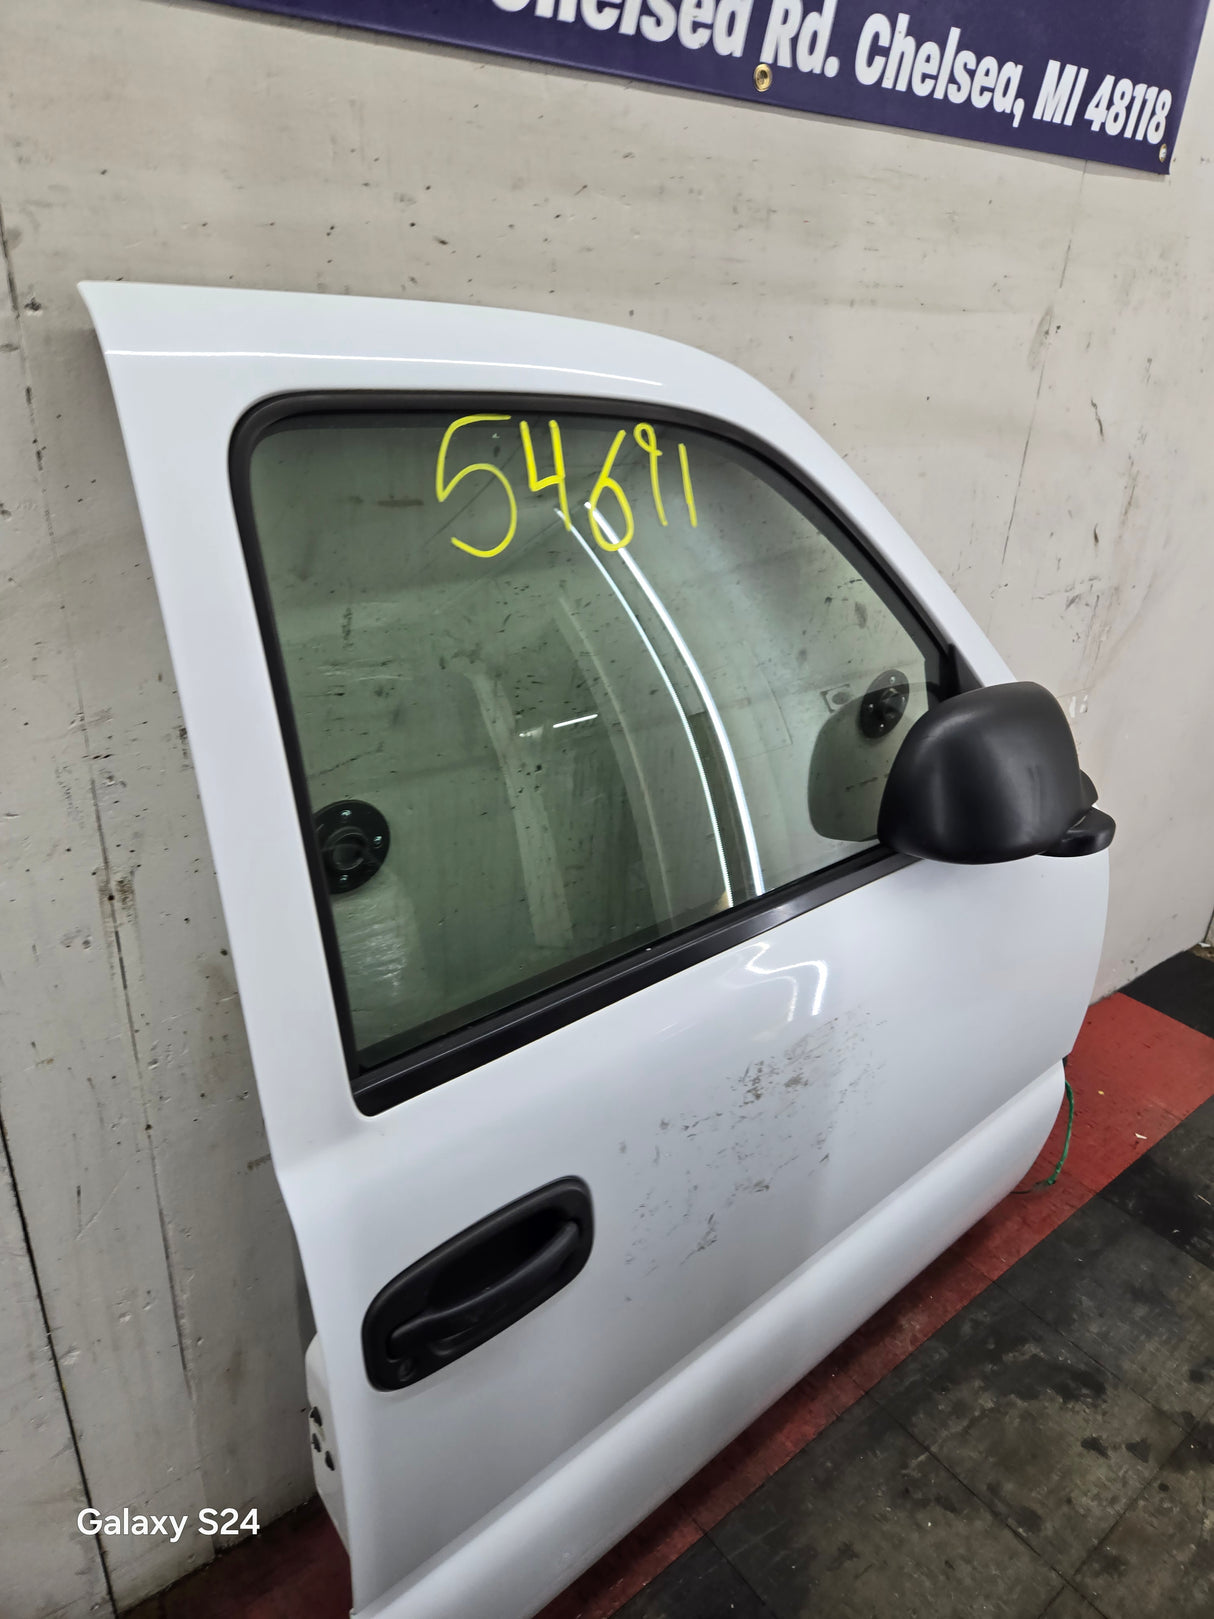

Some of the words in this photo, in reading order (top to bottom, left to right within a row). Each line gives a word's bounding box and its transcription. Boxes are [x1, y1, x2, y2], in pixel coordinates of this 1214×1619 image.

[491, 0, 752, 57] esea
[759, 0, 841, 77] Rd.
[854, 12, 1026, 128] Chelsea,
[1032, 59, 1090, 126] MI
[1084, 74, 1173, 144] 48118
[436, 413, 698, 558] 54691
